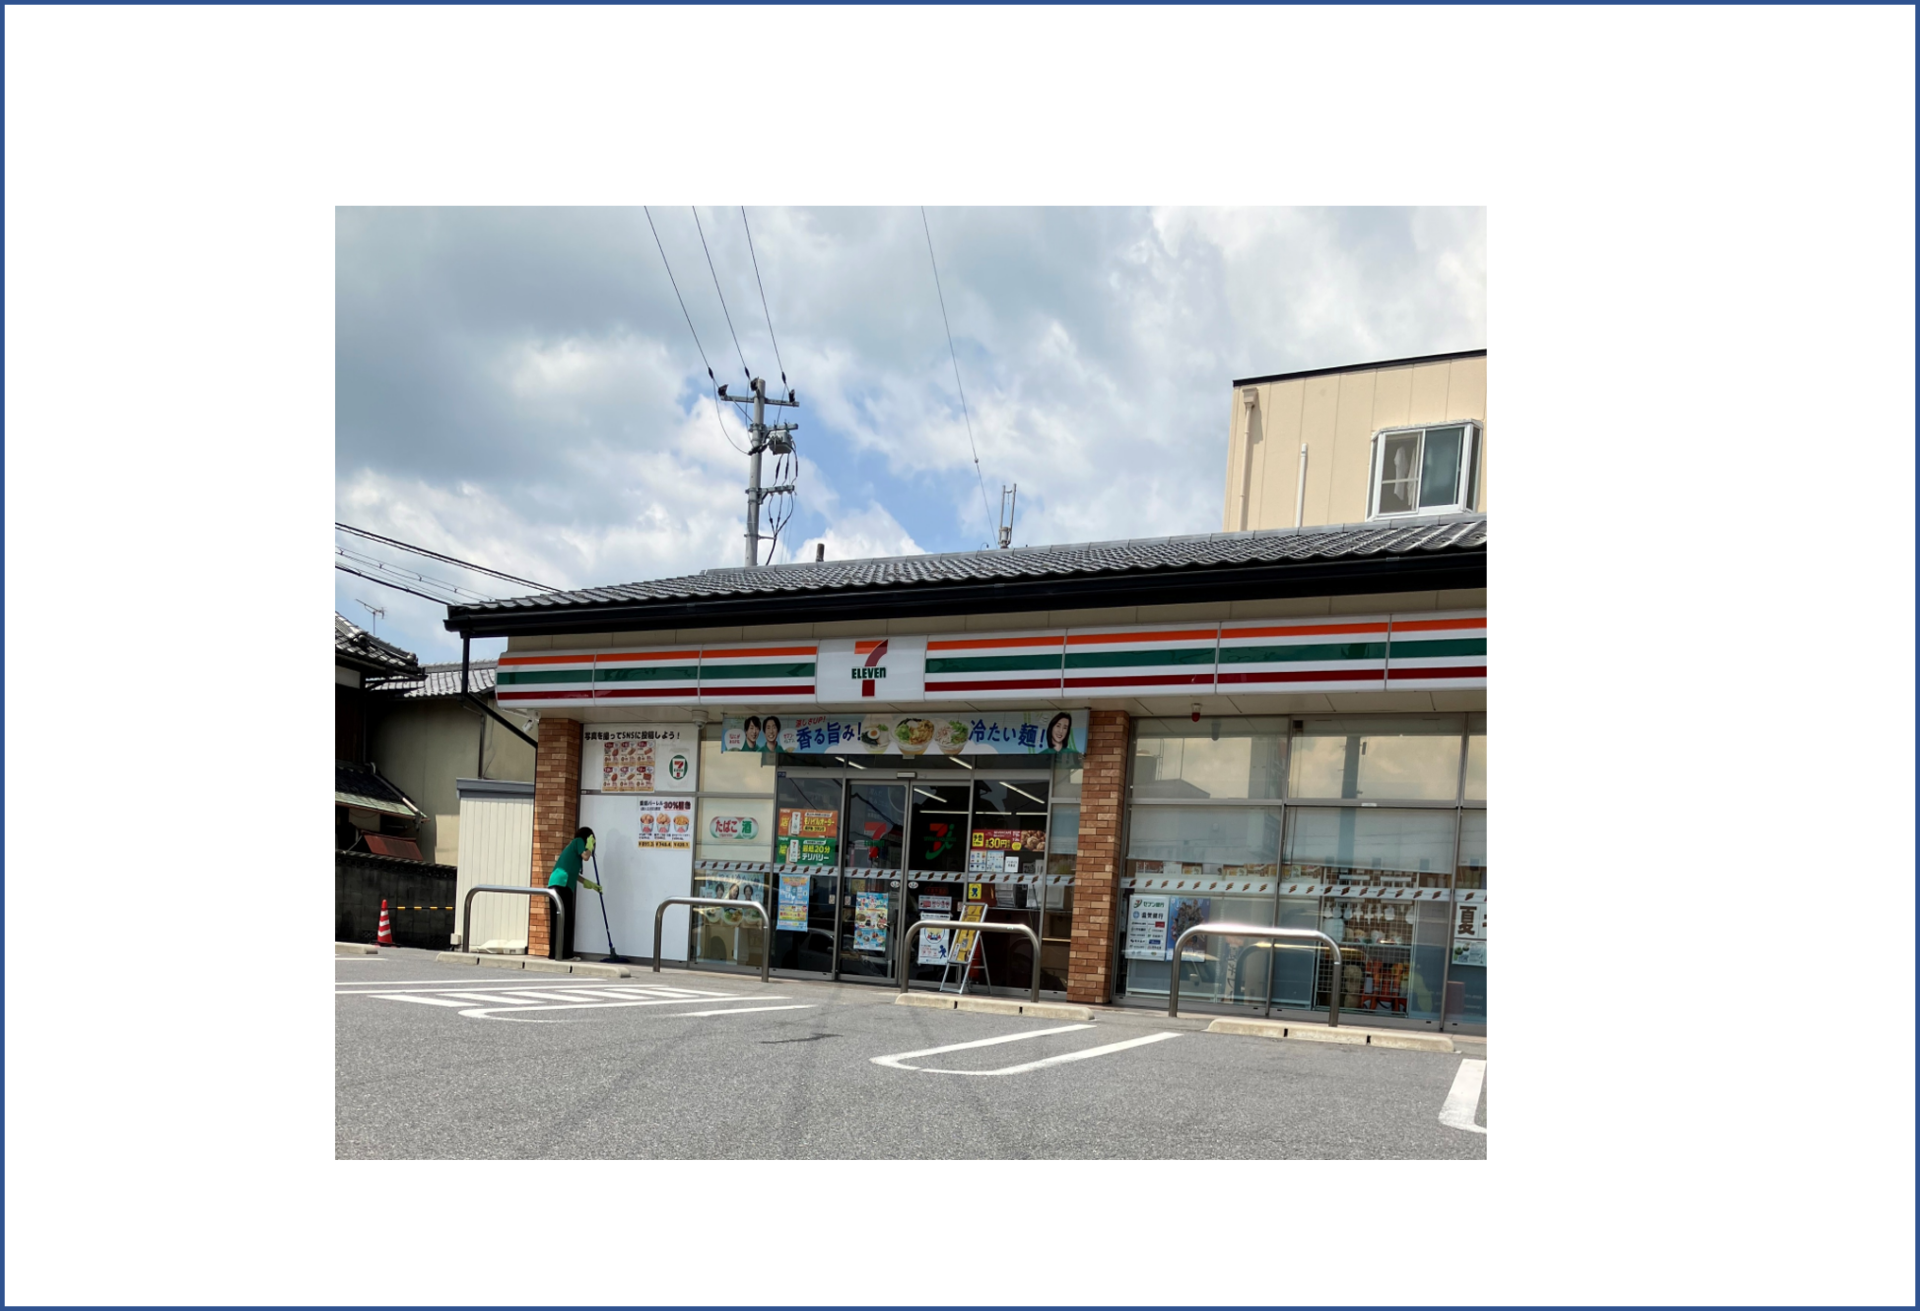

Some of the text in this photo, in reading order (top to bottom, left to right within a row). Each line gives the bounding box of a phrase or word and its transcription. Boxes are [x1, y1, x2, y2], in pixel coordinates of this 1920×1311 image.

[854, 639, 889, 697] 7
[715, 819, 753, 834] たばこ 酒
